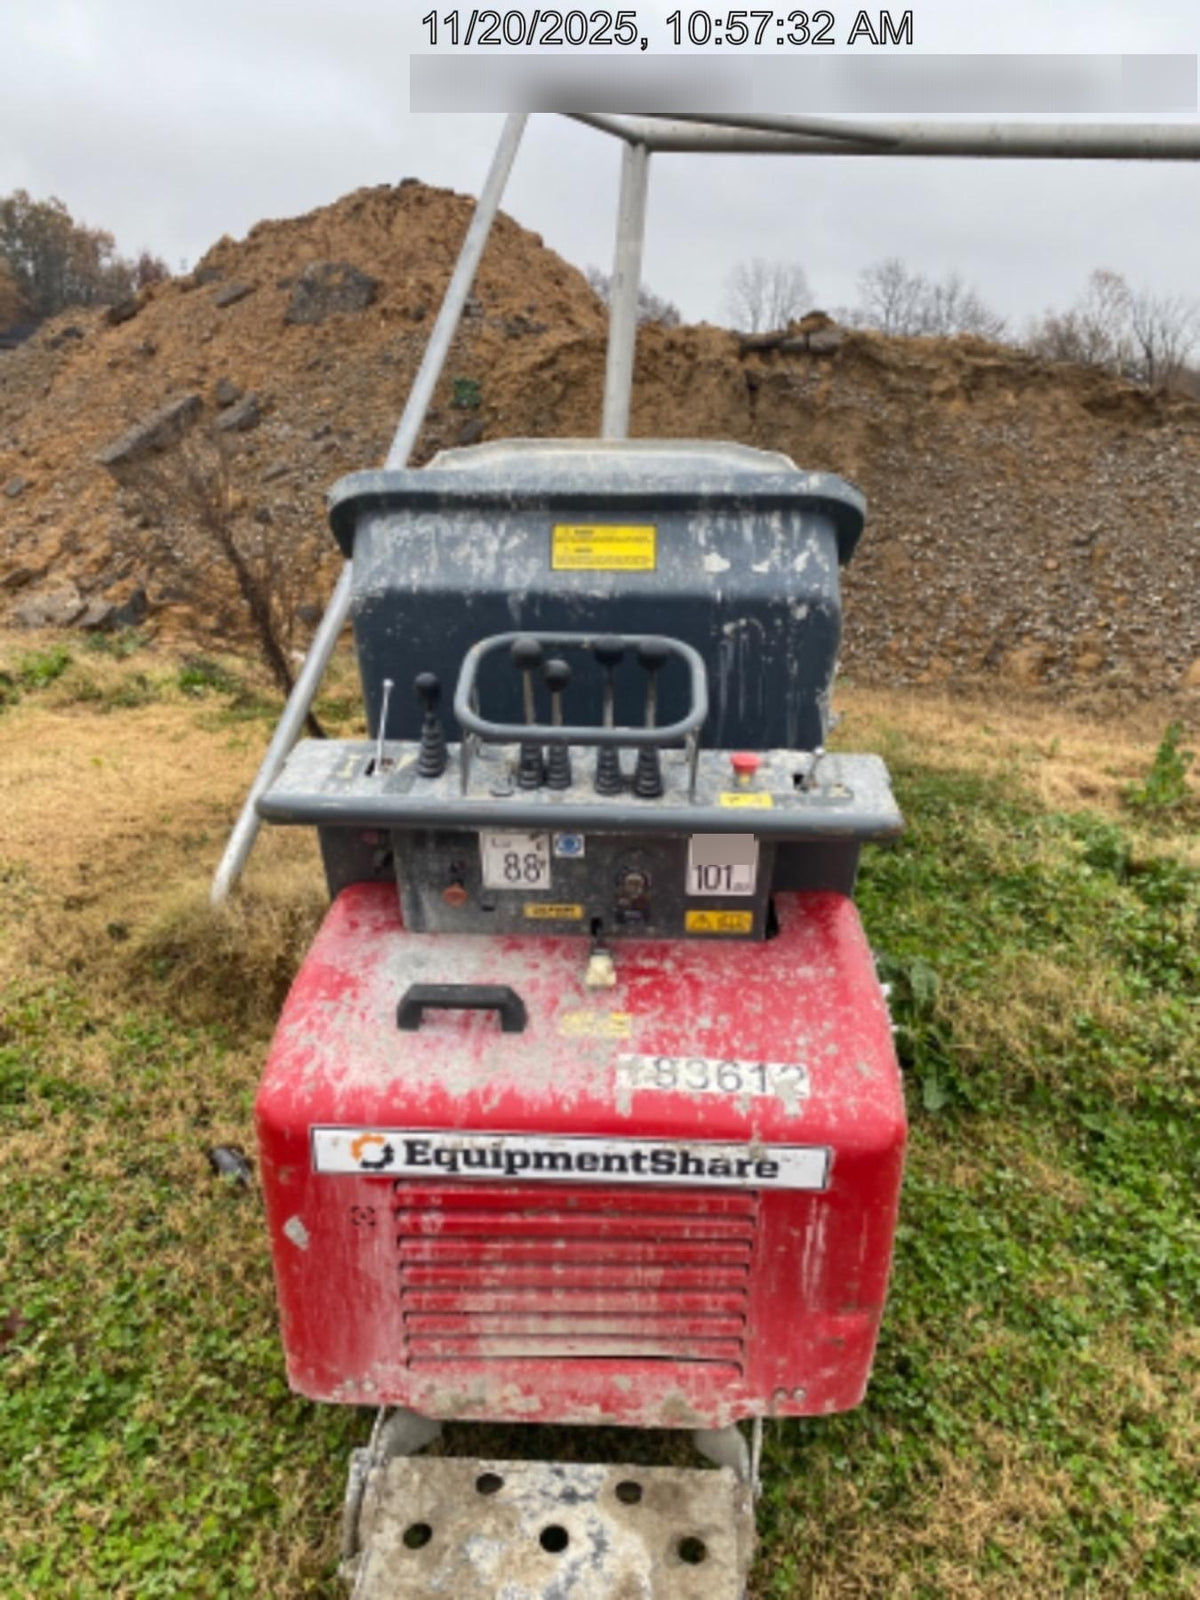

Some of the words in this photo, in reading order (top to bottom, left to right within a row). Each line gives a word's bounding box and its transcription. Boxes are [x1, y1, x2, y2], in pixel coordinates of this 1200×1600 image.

[504, 852, 541, 882] 88
[693, 864, 732, 890] 101
[628, 1056, 807, 1096] 83612
[405, 1139, 779, 1178] EquipmentShare
